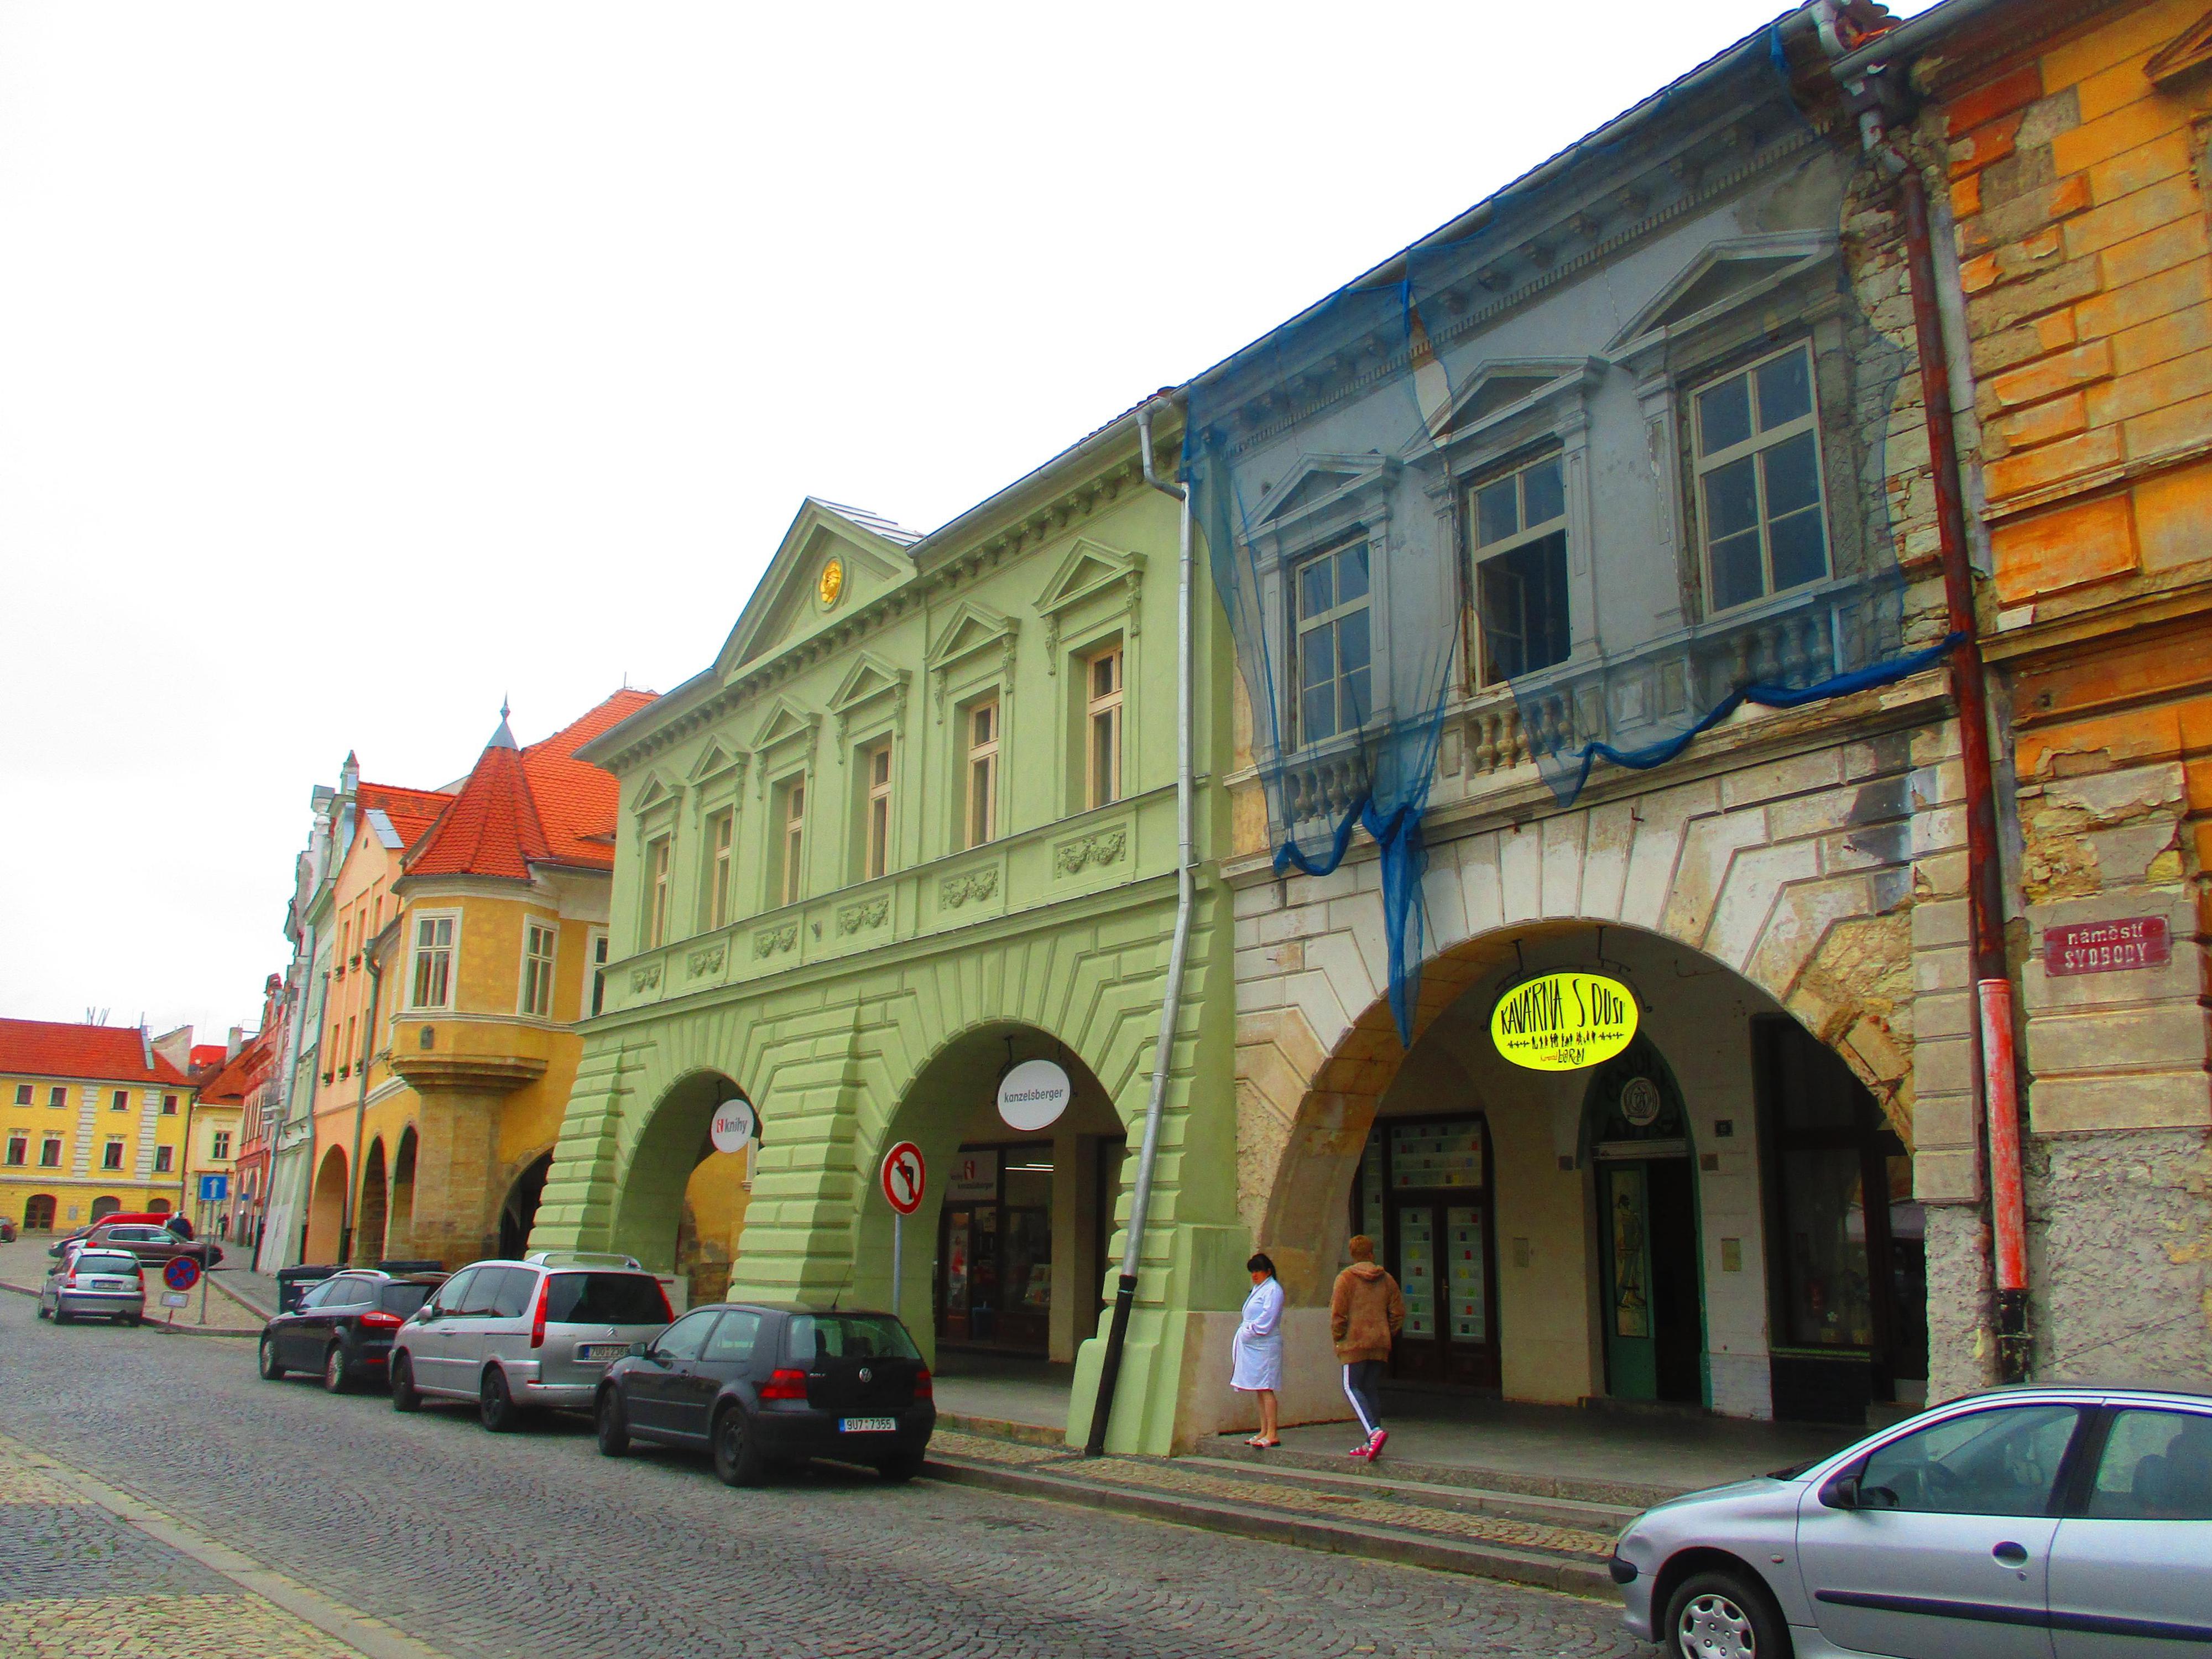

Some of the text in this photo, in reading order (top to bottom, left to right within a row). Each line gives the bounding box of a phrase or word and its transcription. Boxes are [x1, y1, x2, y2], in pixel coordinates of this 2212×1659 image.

[2067, 921, 2144, 945] náměstí
[2064, 942, 2148, 968] SVOBODY
[1500, 978, 1564, 1035] KAVÁRNA
[1572, 978, 1585, 1027] S
[1004, 1088, 1063, 1103] kanzelsberger
[724, 1117, 748, 1135] knihy
[846, 1418, 891, 1430] 9U7 7355
